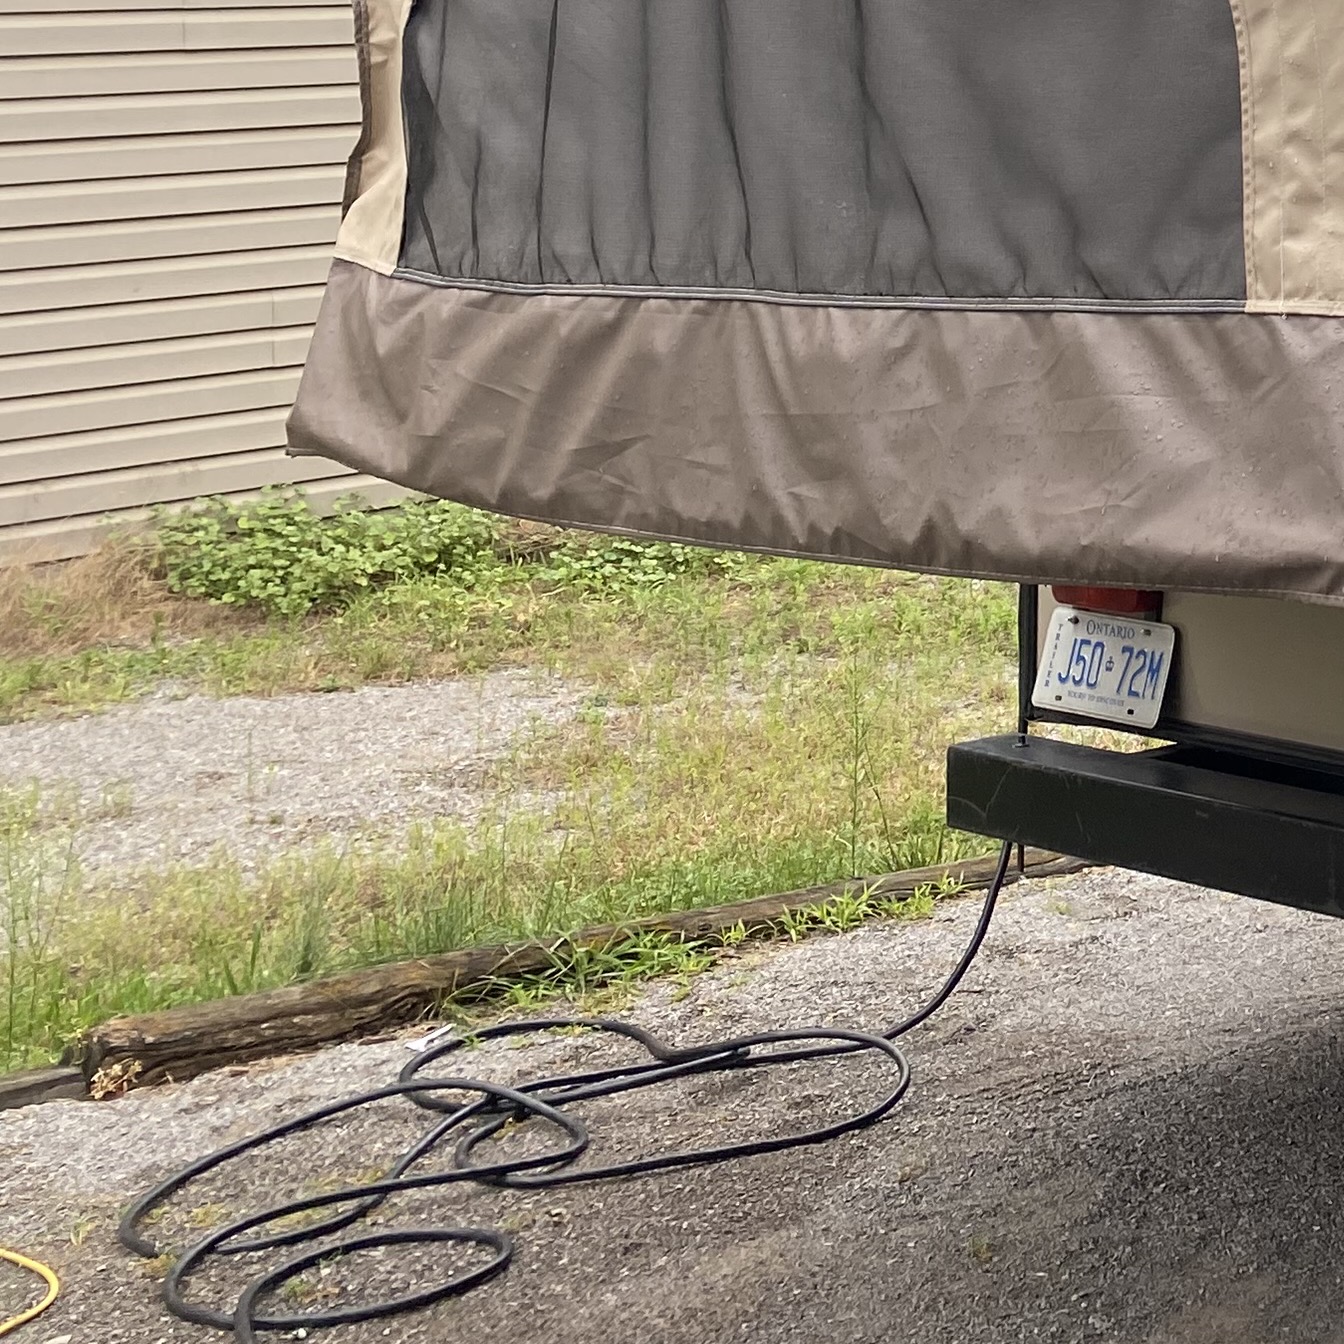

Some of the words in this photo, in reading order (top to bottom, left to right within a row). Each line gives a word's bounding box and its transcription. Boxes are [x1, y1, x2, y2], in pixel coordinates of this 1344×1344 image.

[1044, 623, 1064, 687] TRAILER
[1086, 619, 1135, 639] ONTARIO
[1115, 645, 1164, 700] 72M
